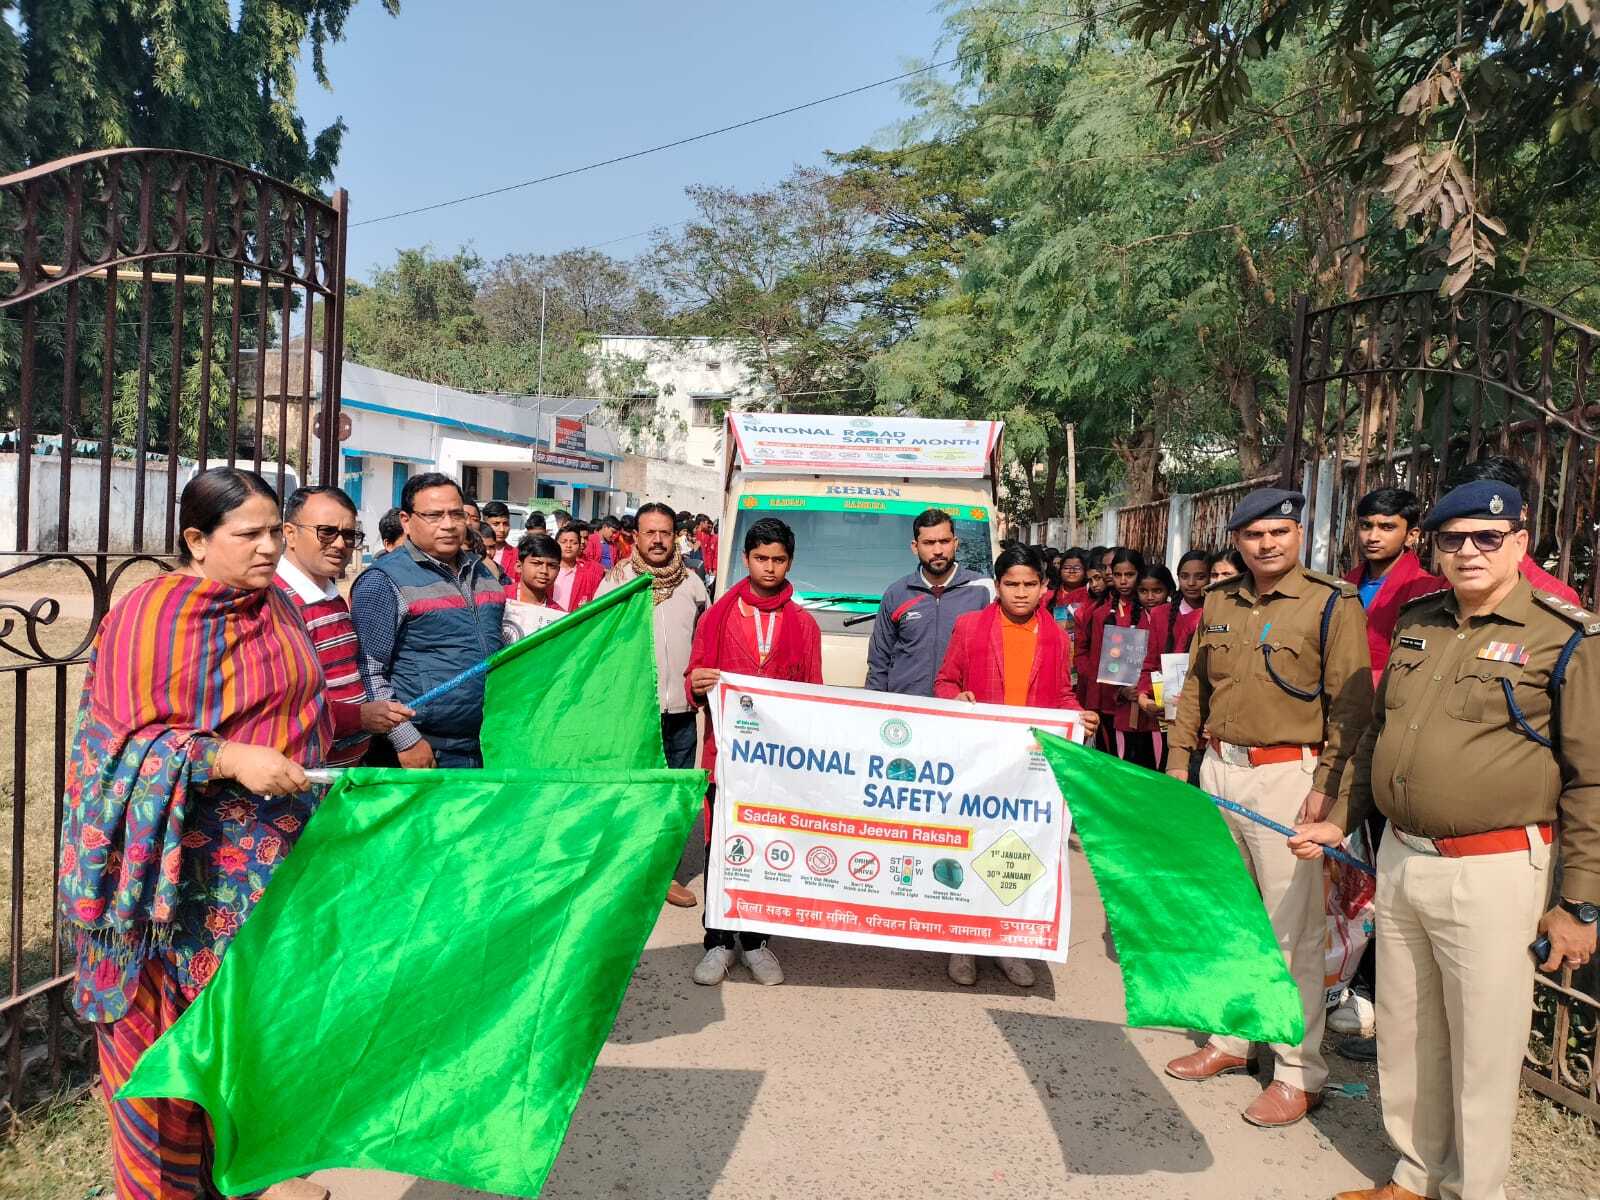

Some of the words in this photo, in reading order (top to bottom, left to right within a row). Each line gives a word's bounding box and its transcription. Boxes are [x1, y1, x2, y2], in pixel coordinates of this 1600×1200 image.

[744, 425, 834, 436] NATIONAL
[842, 437, 906, 445] SAFETY
[731, 738, 856, 776] NATIONAL
[863, 783, 953, 814] SAFETY
[959, 793, 1052, 824] MONTH
[743, 809, 787, 825] Sadak
[790, 815, 856, 835] Suraksha
[859, 823, 908, 840] Jeevan
[912, 828, 962, 845] Raksha
[770, 848, 790, 862] 50
[1001, 850, 1031, 860] JANUARY
[1006, 861, 1015, 869] TO
[1002, 871, 1031, 881] JANUARY
[1000, 881, 1017, 890] 2025
[736, 898, 763, 913] जिला
